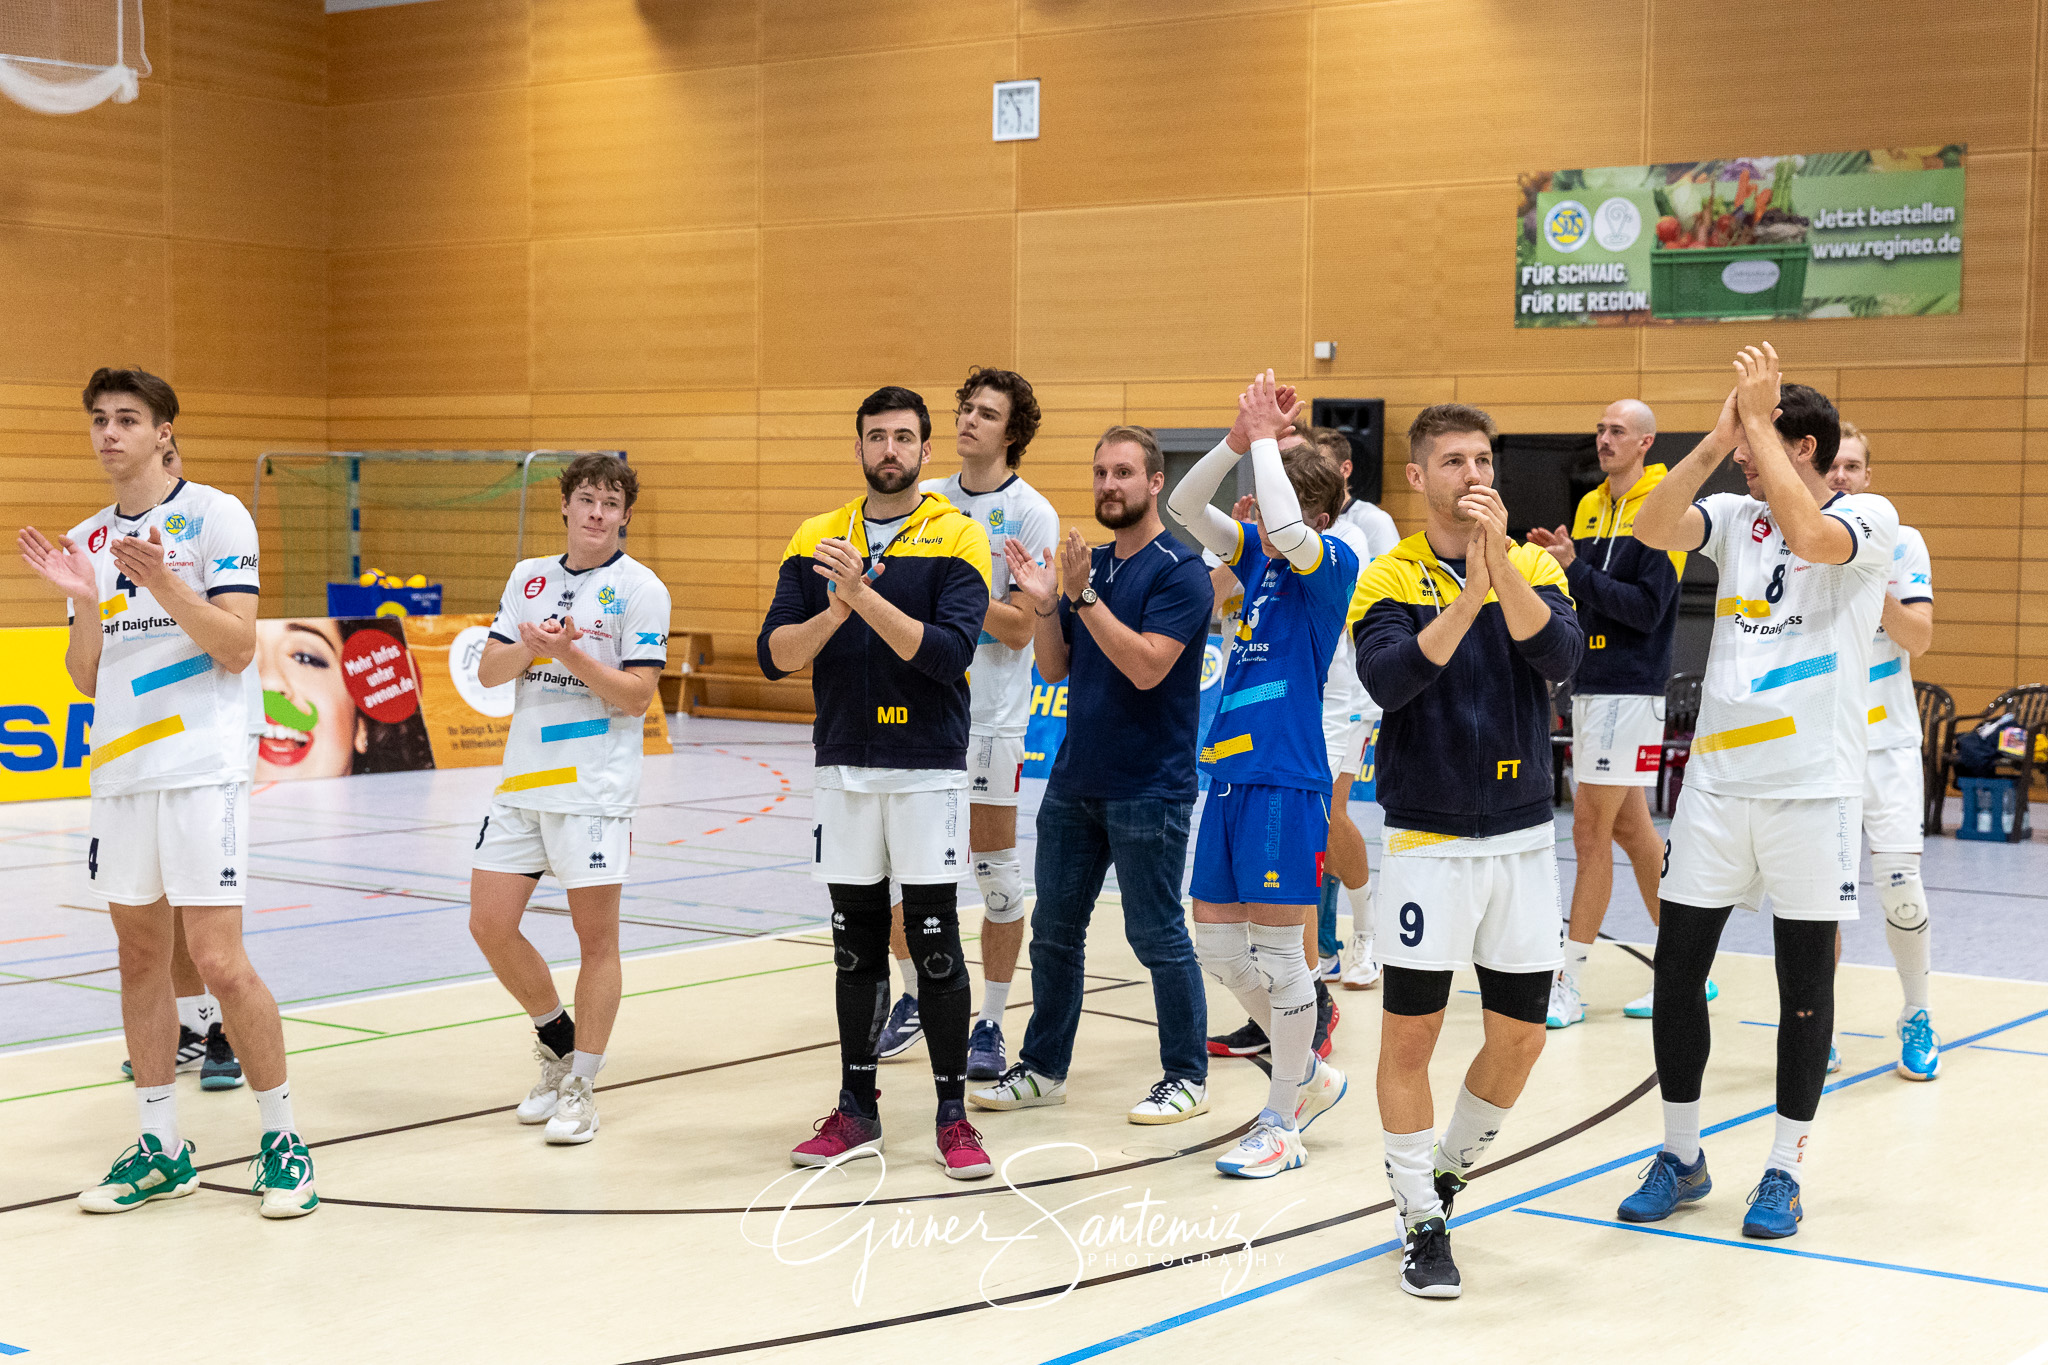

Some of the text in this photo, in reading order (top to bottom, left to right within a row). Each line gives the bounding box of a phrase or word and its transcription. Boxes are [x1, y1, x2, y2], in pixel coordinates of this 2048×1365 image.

[1814, 202, 1956, 229] Jetzt bestellen
[1813, 232, 1962, 261] www.regineo.de
[1521, 262, 1628, 286] FÜR SCHWAIG.
[1521, 290, 1650, 314] FÜR DIE REGION.
[1765, 564, 1786, 604] 8
[122, 617, 177, 632] Daigfuss
[1589, 635, 1606, 649] LD
[370, 645, 401, 666] Infos
[366, 665, 395, 688] unter
[543, 672, 589, 687] Daigfus
[877, 706, 908, 724] MD
[1497, 759, 1522, 780] FT
[923, 926, 942, 935] errea
[1399, 901, 1424, 948] 9
